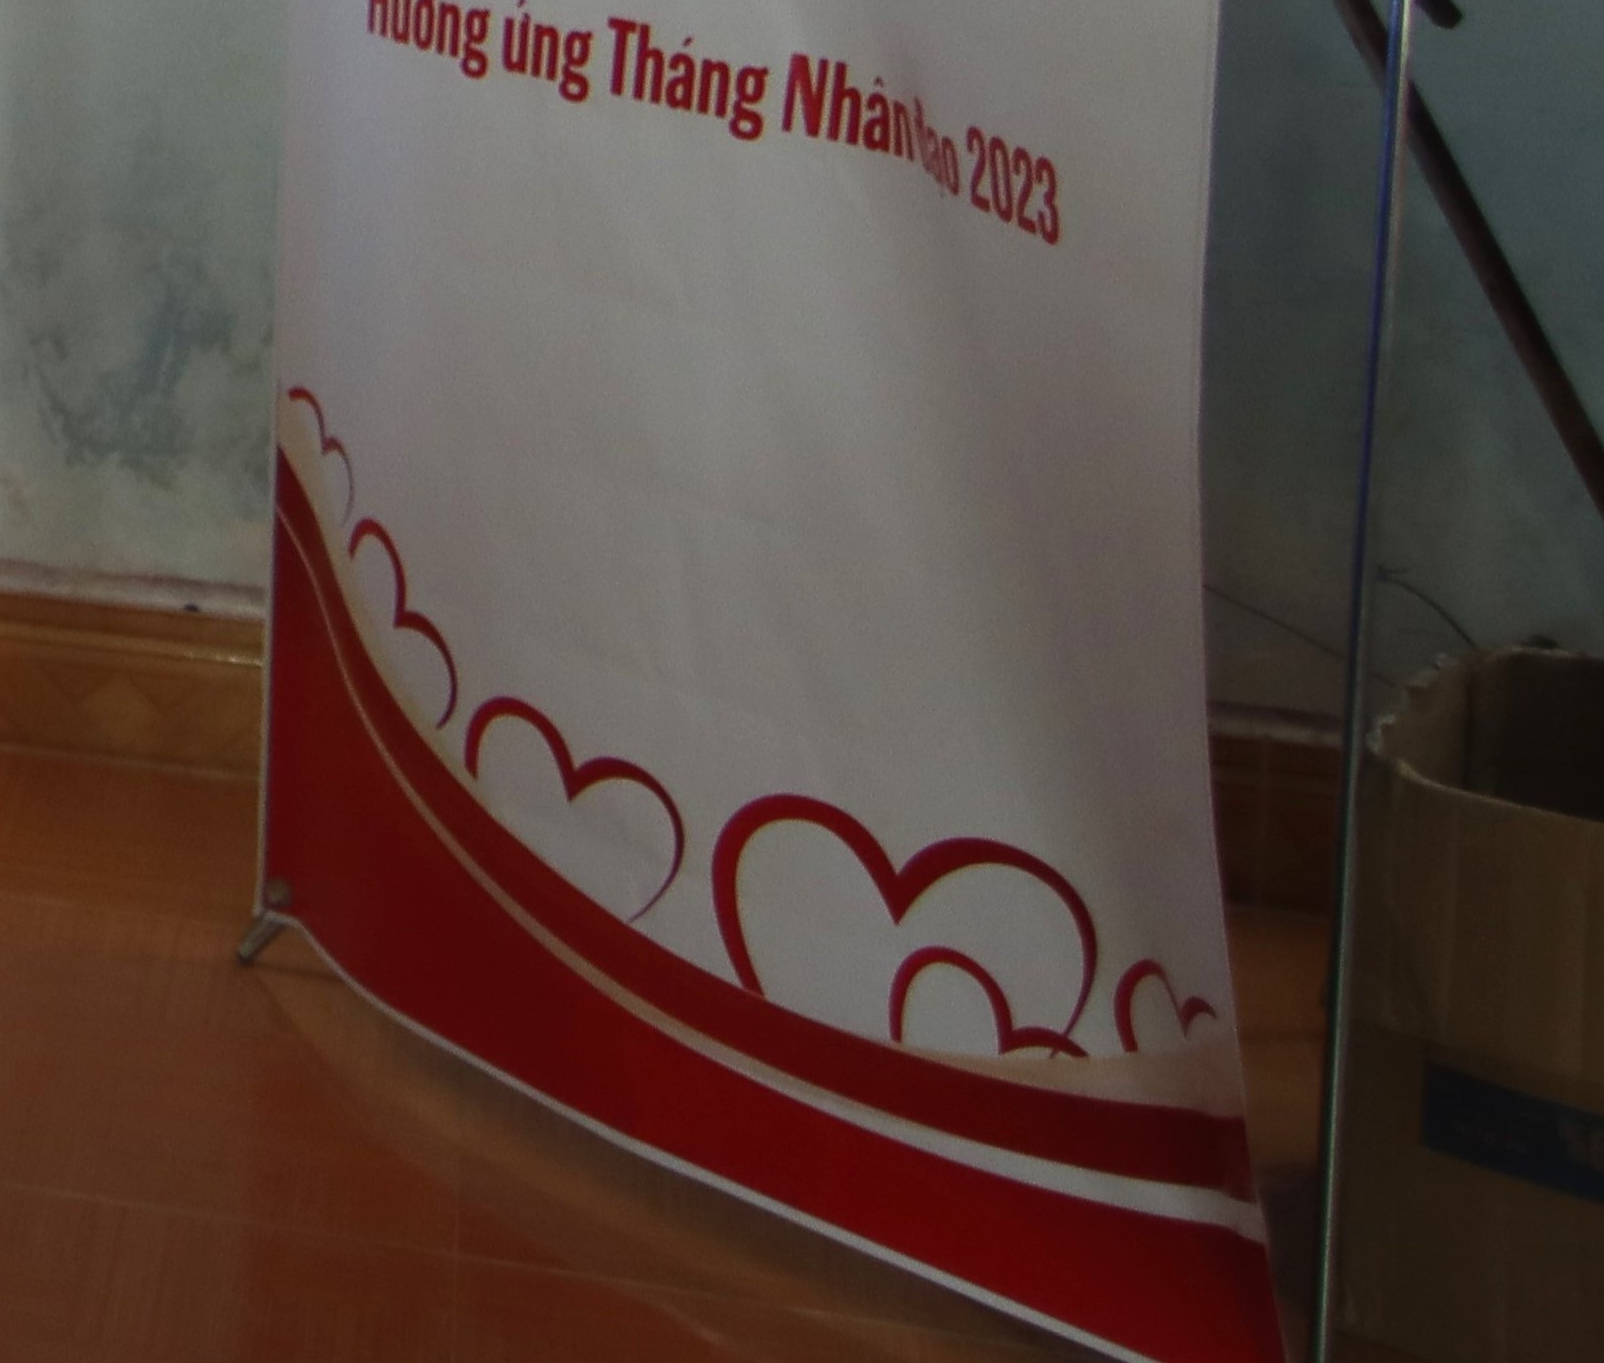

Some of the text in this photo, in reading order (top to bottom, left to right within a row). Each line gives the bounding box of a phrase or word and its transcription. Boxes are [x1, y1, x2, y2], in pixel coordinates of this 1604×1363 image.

[607, 16, 770, 142] Tháng
[782, 53, 914, 163] Nhân
[967, 125, 1060, 246] 2023
